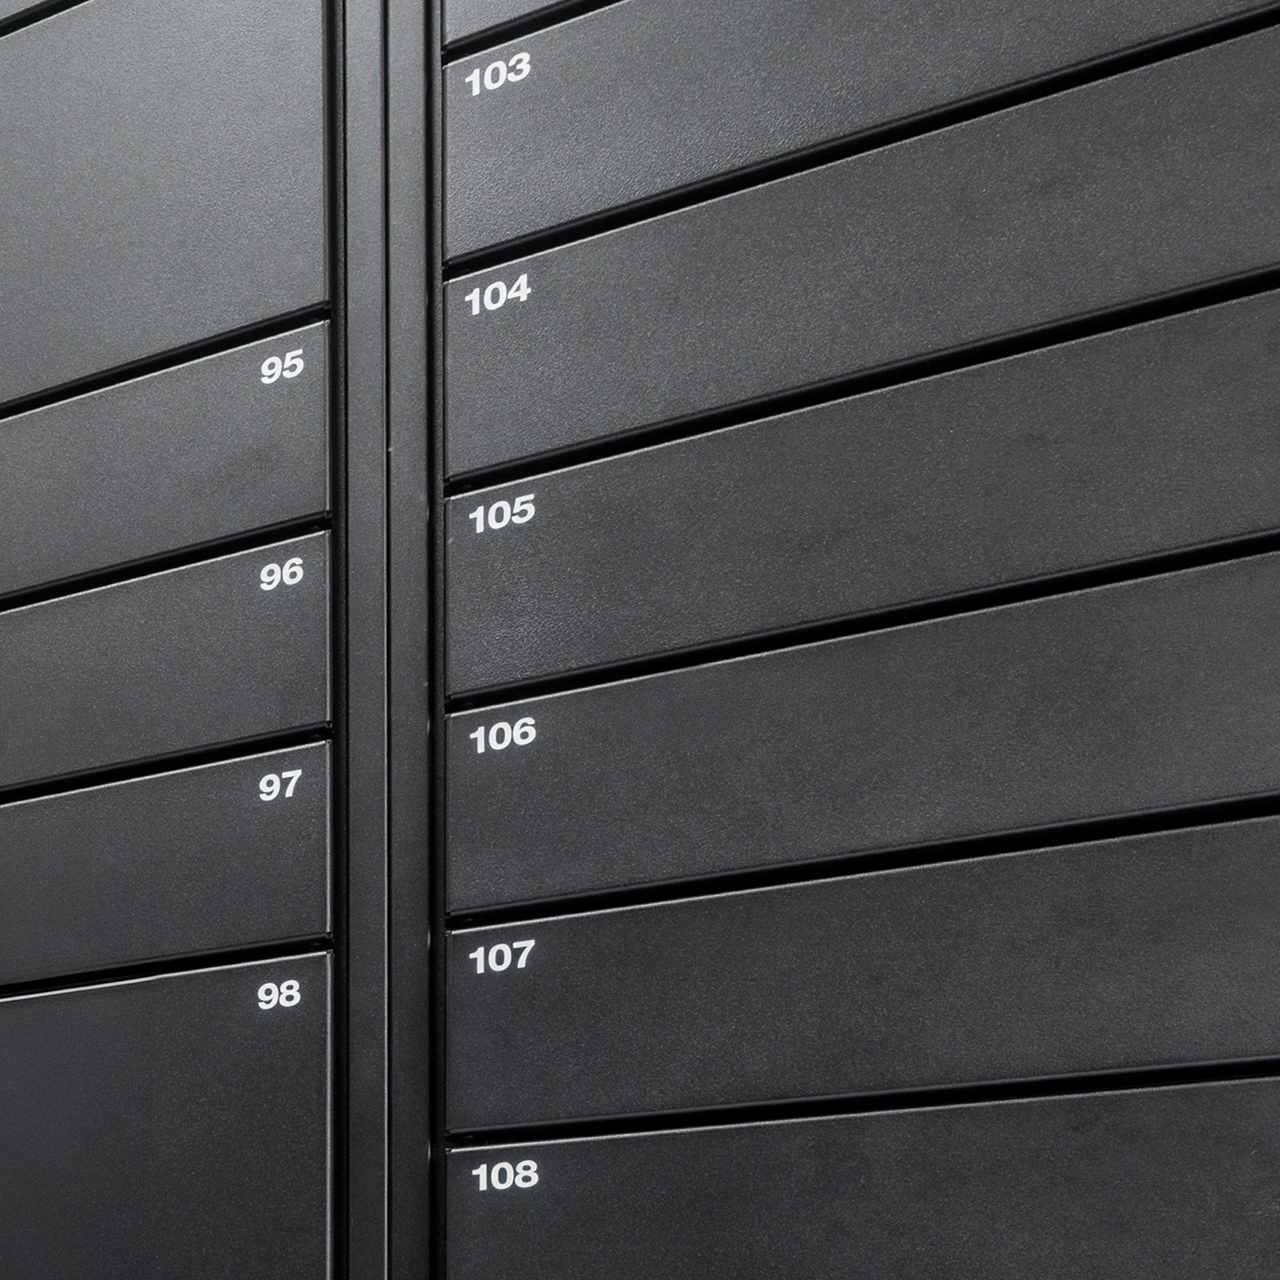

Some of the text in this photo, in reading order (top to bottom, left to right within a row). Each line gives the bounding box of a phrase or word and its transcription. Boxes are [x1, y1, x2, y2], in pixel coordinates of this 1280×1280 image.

[463, 51, 532, 98] 103
[463, 273, 533, 317] 104
[259, 347, 306, 386] 95
[468, 492, 536, 534] 105
[259, 556, 304, 592] 96
[468, 716, 537, 755] 106
[258, 768, 303, 802] 97
[468, 938, 536, 975] 107
[256, 979, 302, 1011] 98
[471, 1159, 540, 1192] 108
